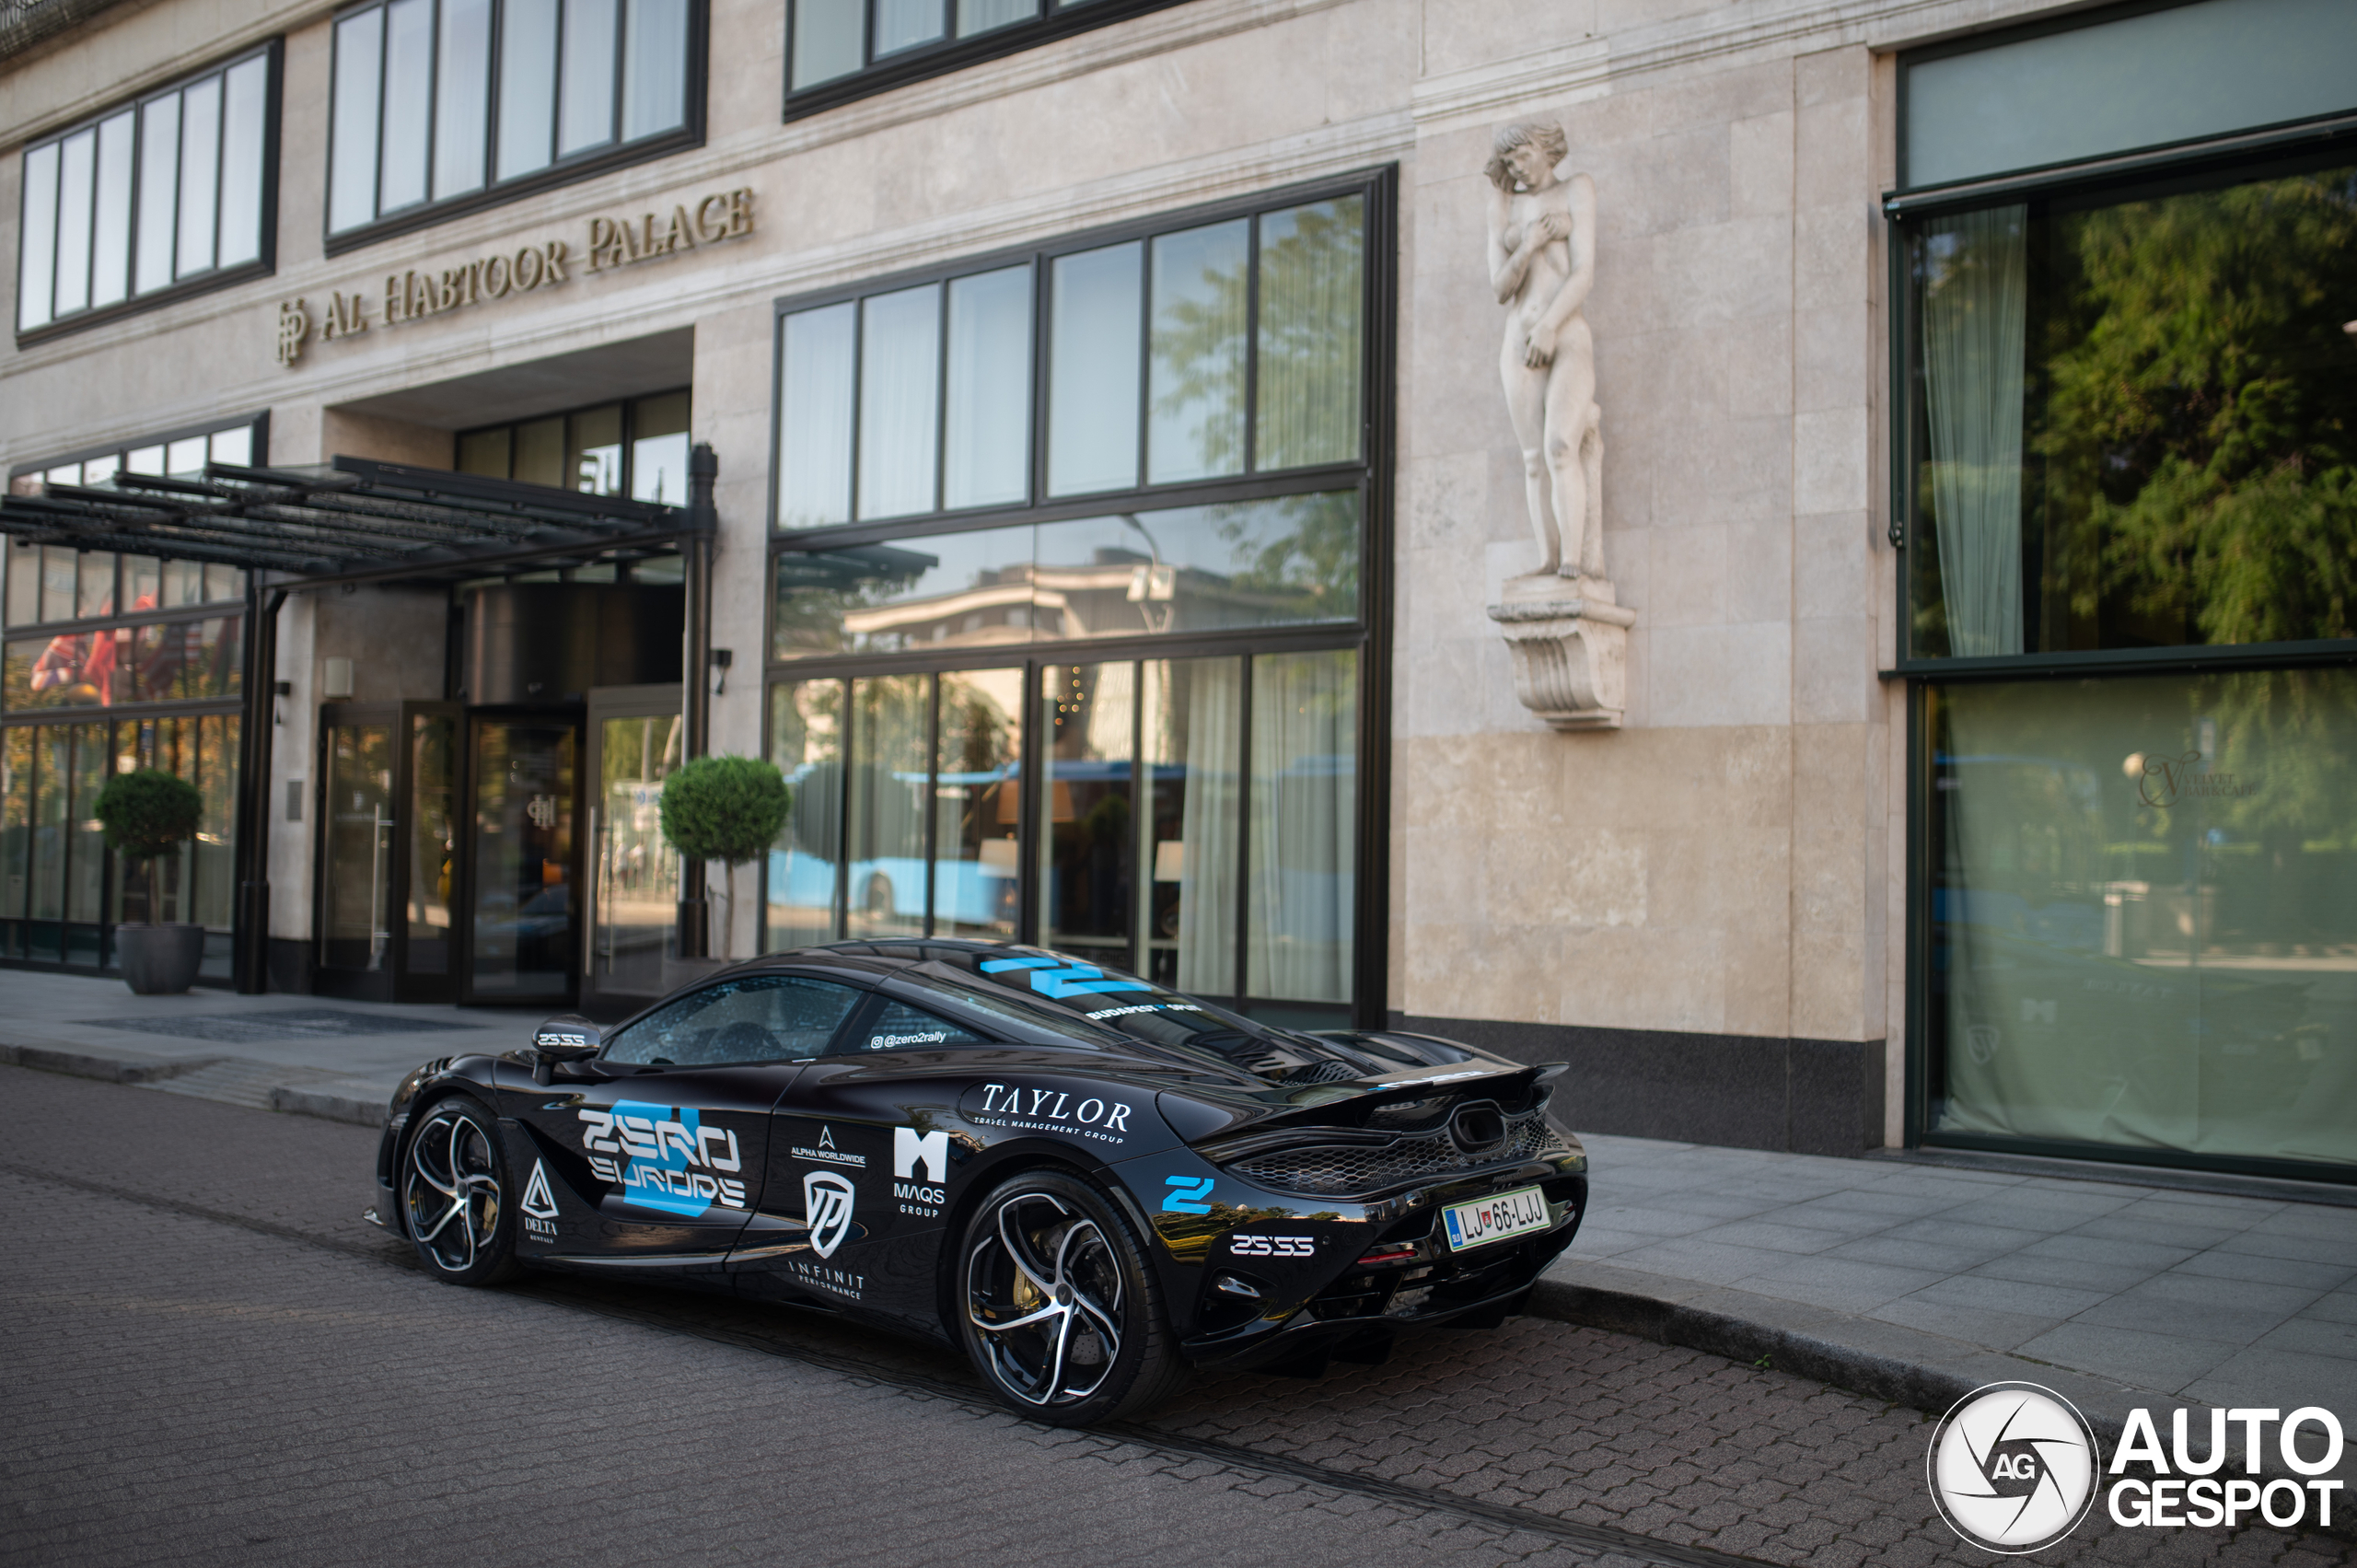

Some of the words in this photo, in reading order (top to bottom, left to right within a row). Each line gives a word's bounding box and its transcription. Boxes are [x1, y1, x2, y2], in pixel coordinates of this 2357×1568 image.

[320, 290, 368, 342] AL
[380, 239, 569, 327] HABTOOR
[584, 186, 753, 273] PALACE
[2185, 773, 2235, 784] VELVET
[1085, 1005, 1159, 1020] BUDAPEST
[884, 1030, 946, 1048] @zero2rally
[981, 1084, 1132, 1132] TAYLOR
[578, 1109, 741, 1172] ZERO
[974, 1117, 1007, 1127] TRAVEL
[1011, 1121, 1081, 1135] MANAGEMENT
[1085, 1131, 1124, 1144] GROUP
[791, 1146, 817, 1157] ALPHA
[817, 1150, 866, 1165] WORLDWIDE
[587, 1156, 745, 1208] EUROPE
[894, 1182, 945, 1204] MAQS
[900, 1204, 938, 1218] GROUP
[524, 1216, 558, 1236] DELTA
[1460, 1207, 1483, 1240] LJ
[529, 1234, 553, 1244] RENTALS
[1452, 1233, 1462, 1243] SLO
[788, 1261, 864, 1290] INFINIT
[798, 1275, 861, 1300] PERFORMANCE
